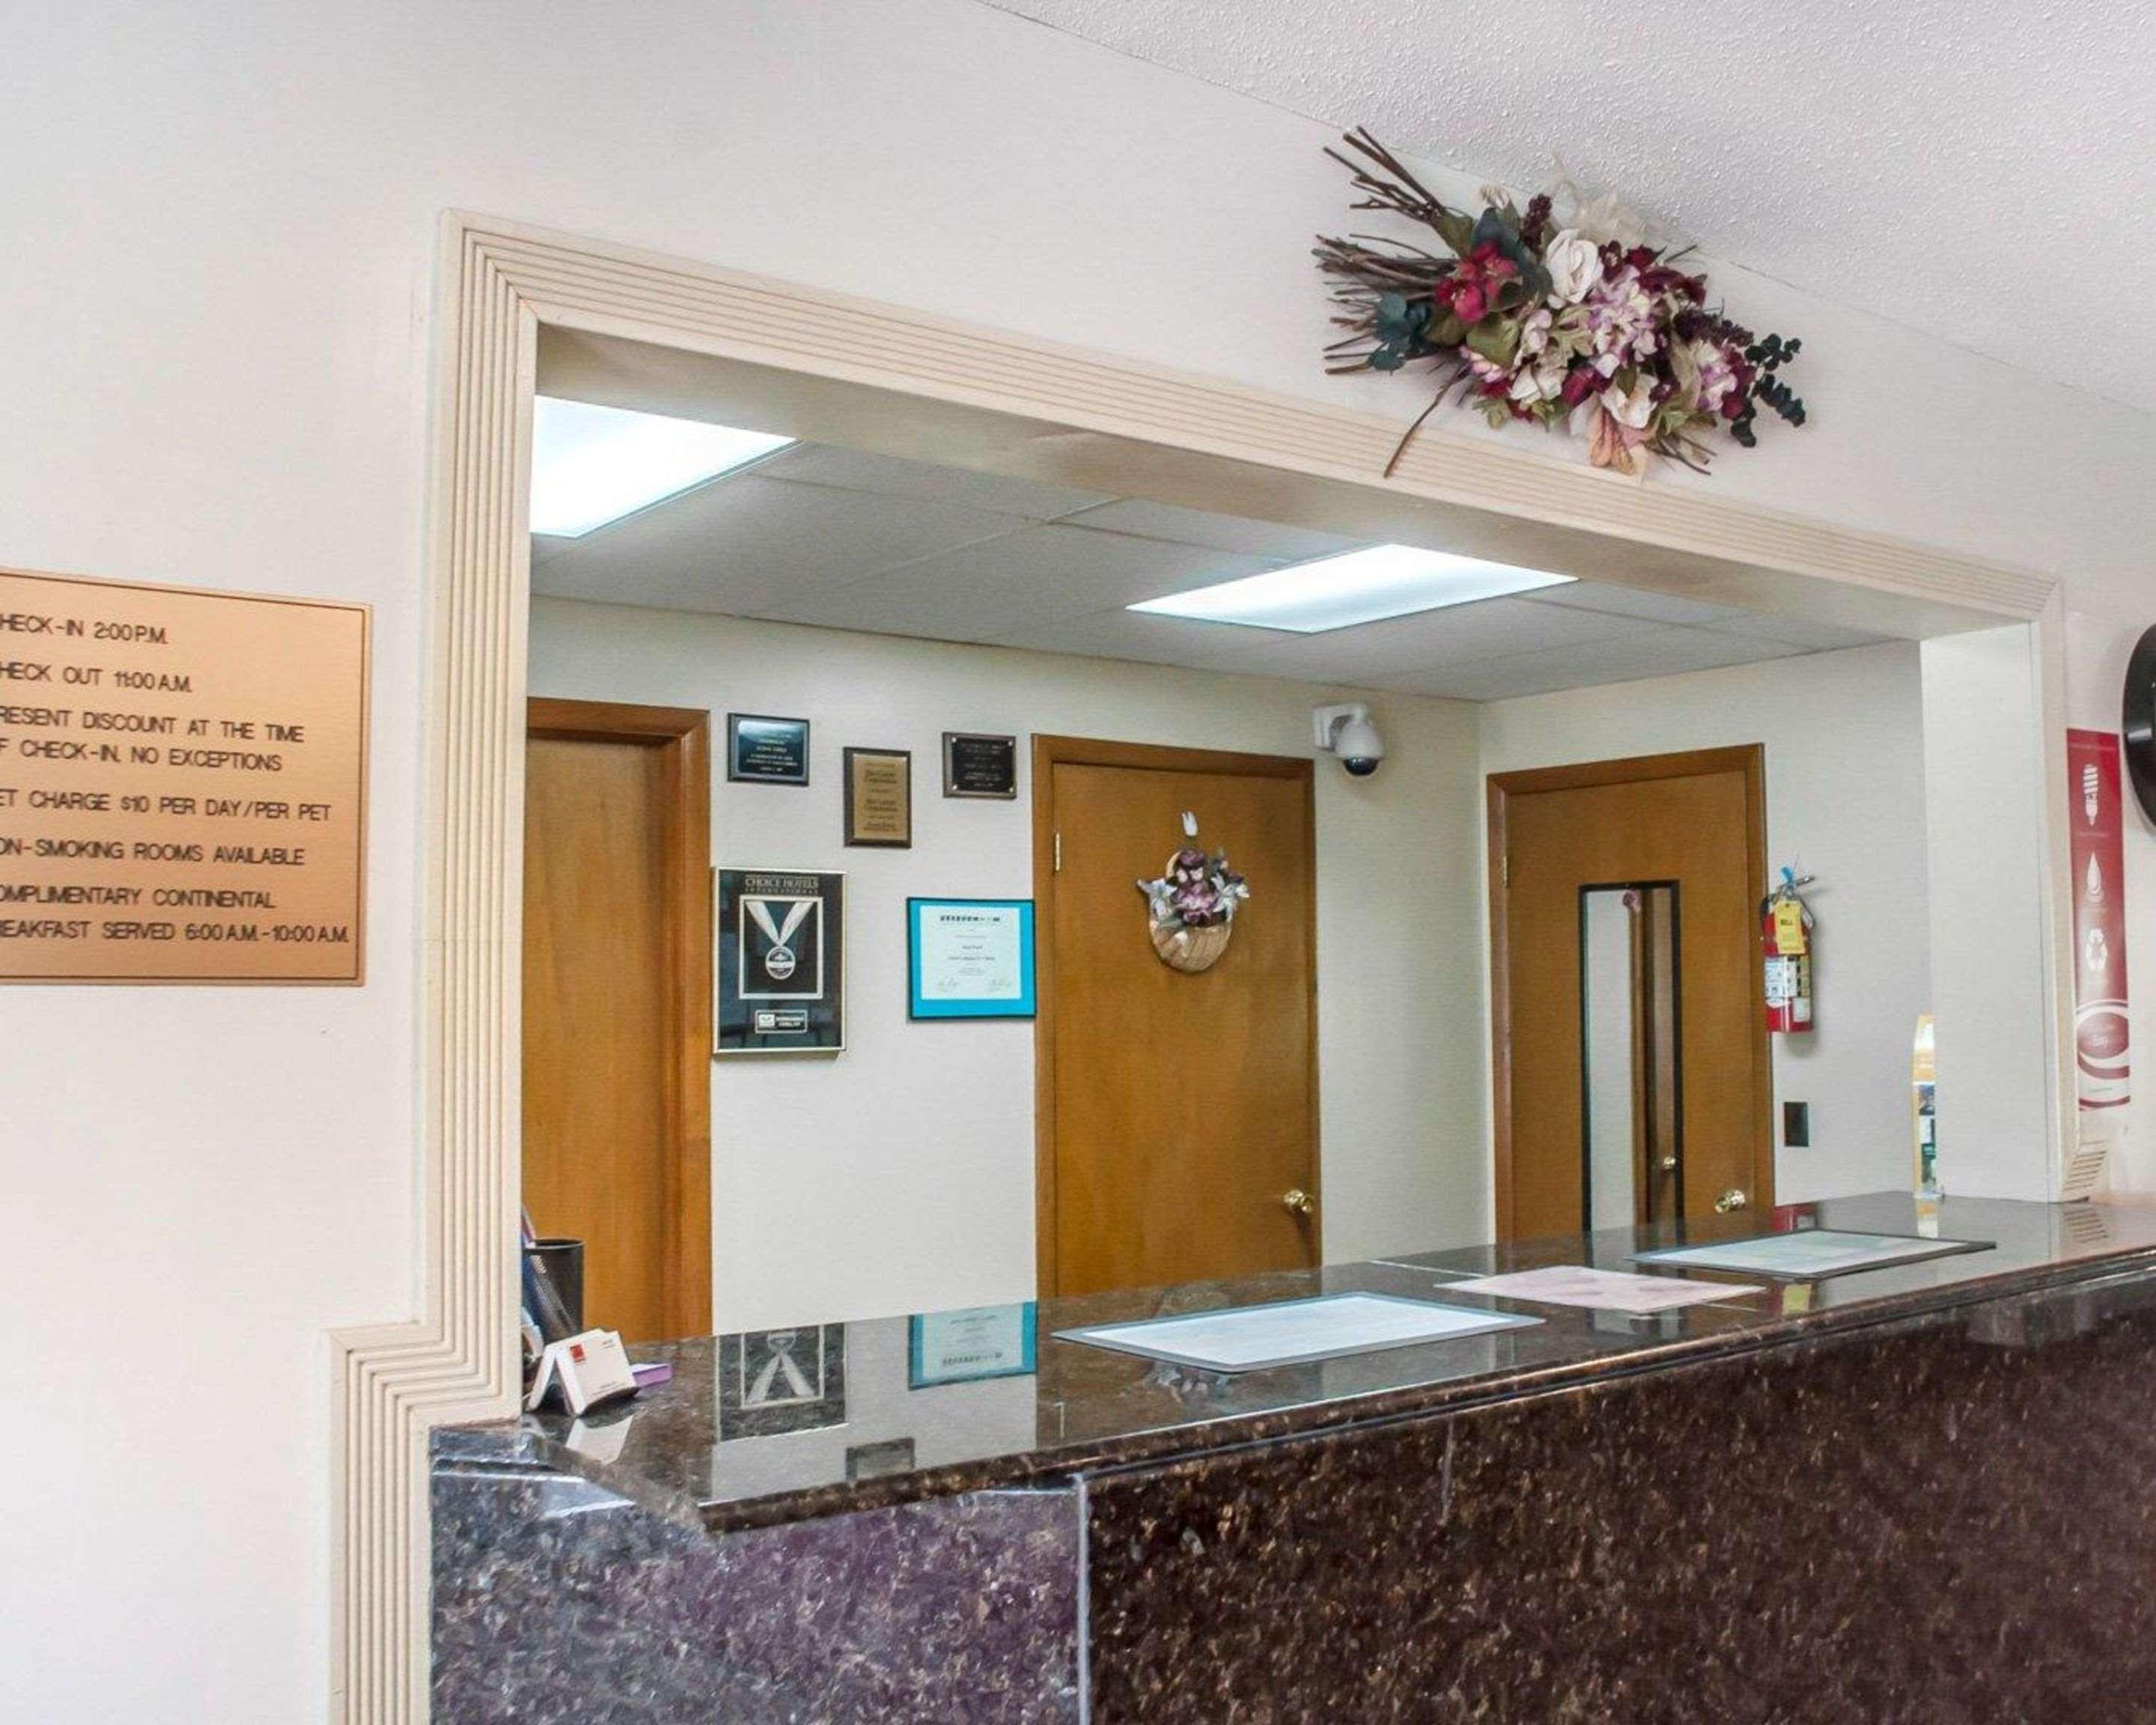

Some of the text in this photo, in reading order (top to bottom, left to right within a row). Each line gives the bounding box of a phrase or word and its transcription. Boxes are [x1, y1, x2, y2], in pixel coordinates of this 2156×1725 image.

[0, 614, 84, 636] HECK-IN
[0, 661, 52, 682] HECK
[62, 666, 103, 685] OUT
[0, 705, 305, 743] RESENT DISCOUNT AT THE TIME
[130, 746, 159, 764] NO
[169, 749, 282, 771] EXCEPTIONS
[29, 791, 110, 811] CHARGE
[121, 795, 150, 813] $10
[159, 796, 195, 815] PER
[299, 803, 332, 821] PET
[0, 837, 305, 865] ON-SMOKING ROOMS AVAILABLE
[0, 884, 276, 908] MPLIMENTARY CONTINENTAL
[0, 919, 91, 938] EAKFAST
[103, 922, 176, 940] SERVED
